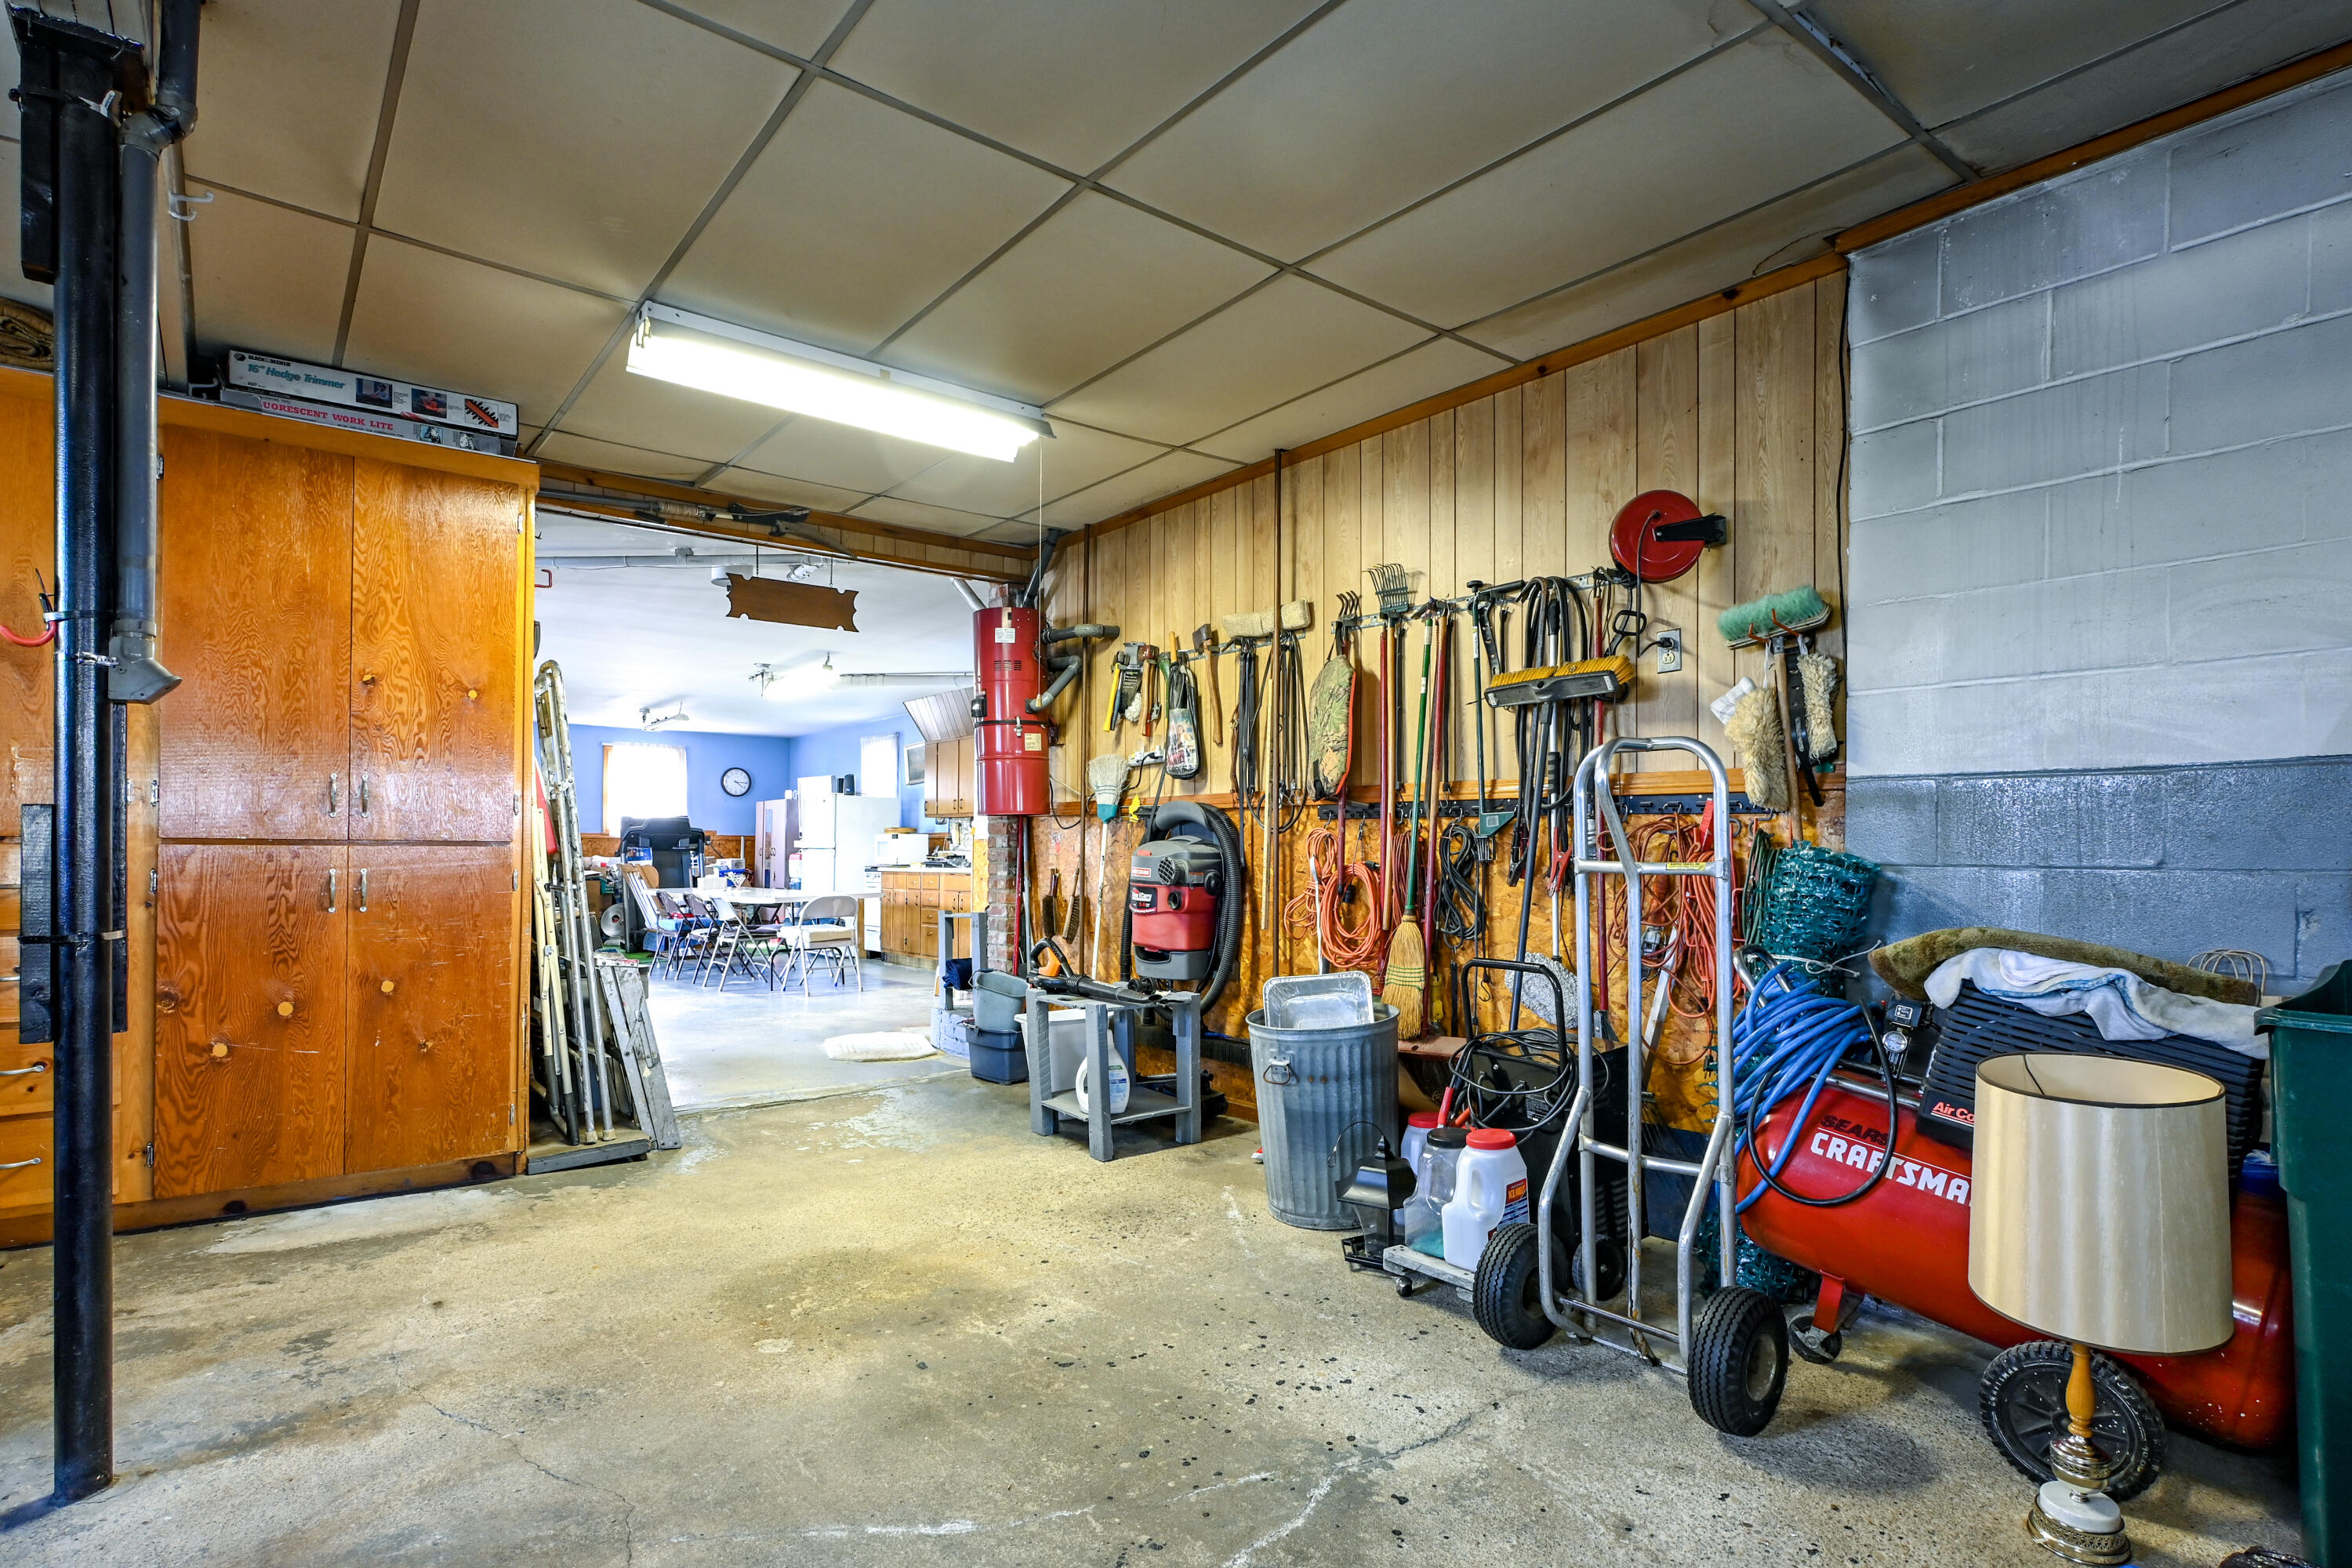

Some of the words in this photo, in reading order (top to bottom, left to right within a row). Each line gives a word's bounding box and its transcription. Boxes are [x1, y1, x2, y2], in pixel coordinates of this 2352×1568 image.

[266, 366, 301, 382] Hedge
[304, 373, 345, 389] Trimmer
[261, 401, 328, 419] UORESCENT
[332, 414, 365, 426] WORK
[370, 420, 394, 430] LITE
[1933, 1102, 1955, 1115] Air
[1820, 1115, 1889, 1146] SEARS
[1810, 1132, 1972, 1207] CRAFTSMA
